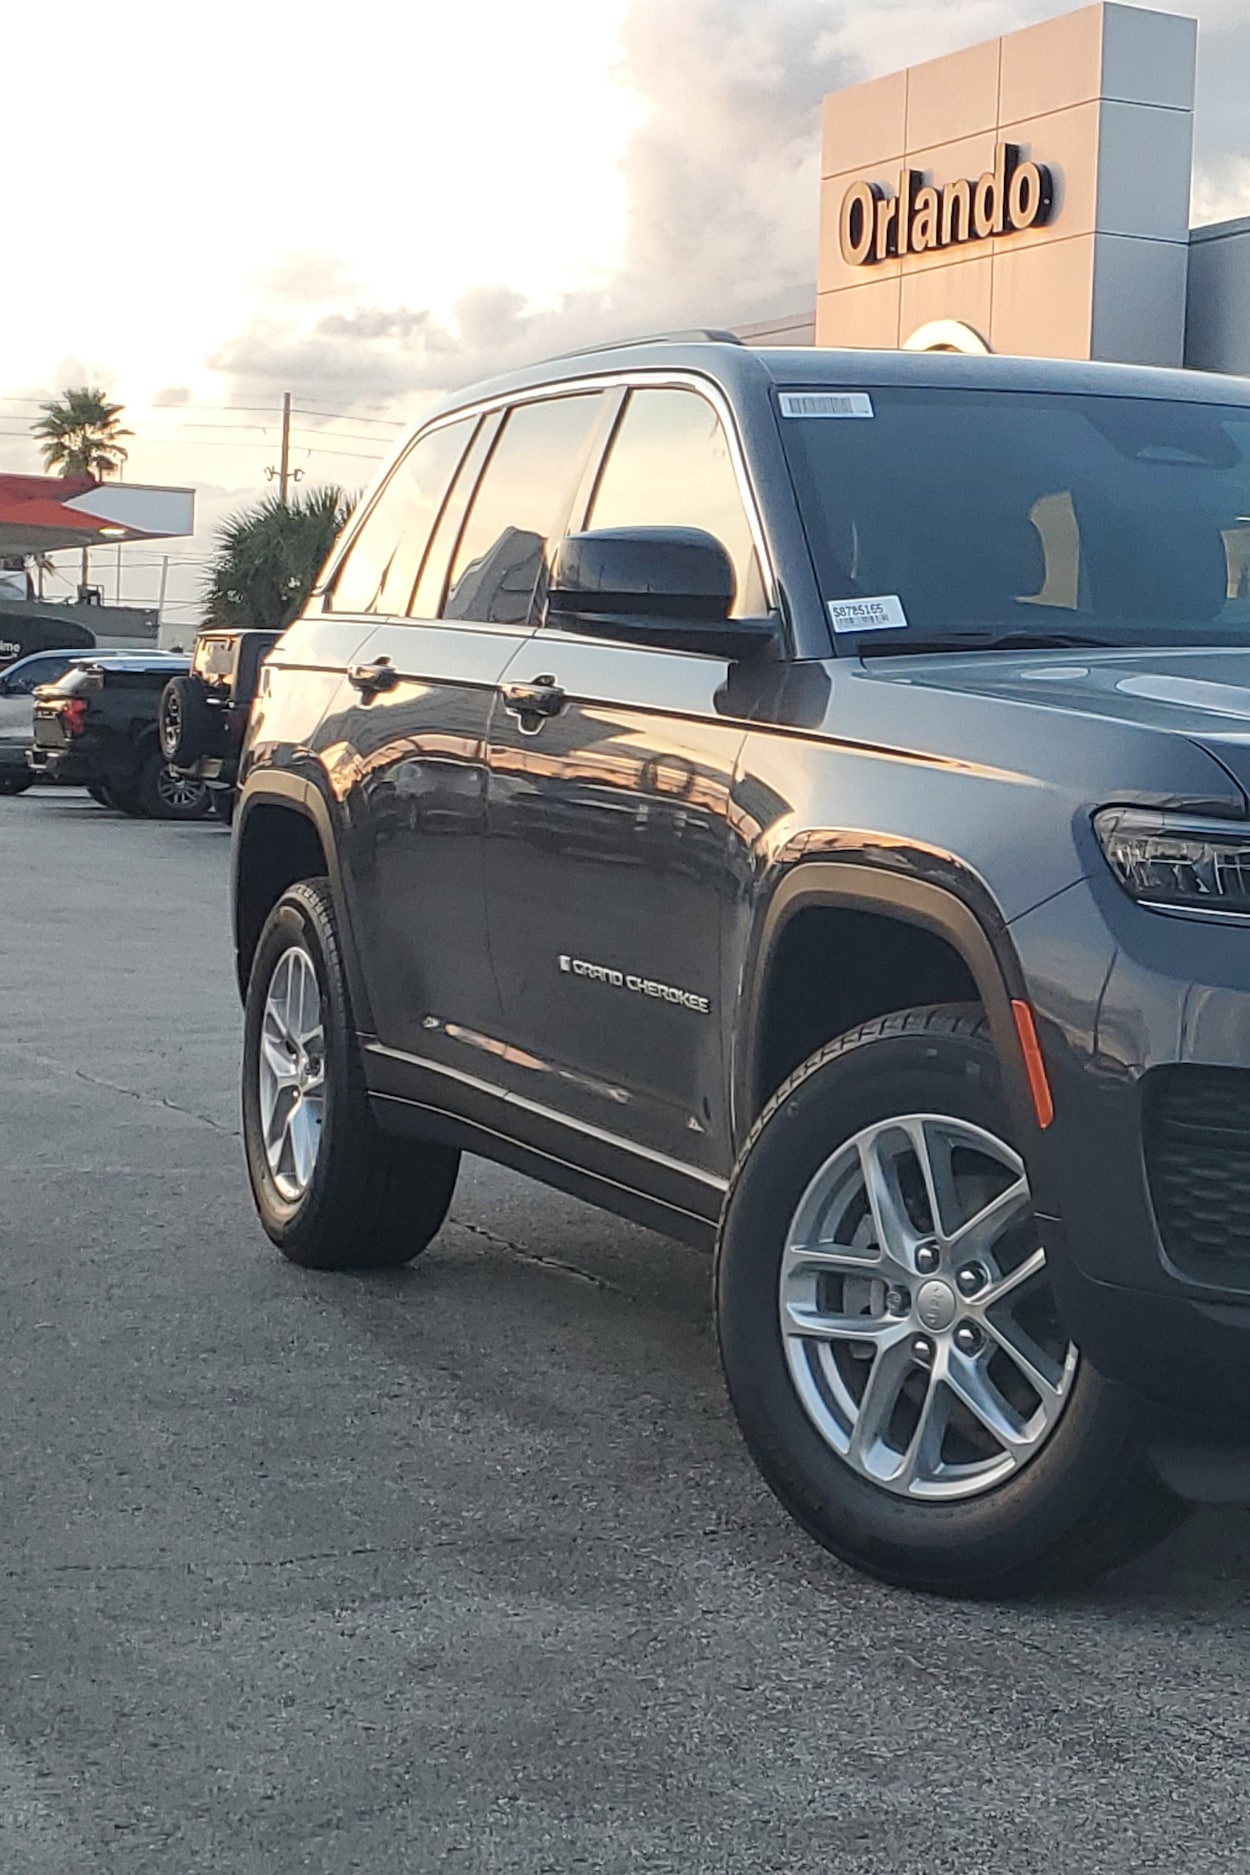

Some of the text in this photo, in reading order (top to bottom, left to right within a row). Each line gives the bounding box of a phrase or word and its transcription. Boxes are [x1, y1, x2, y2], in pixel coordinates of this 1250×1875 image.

[839, 143, 1053, 266] Orlando
[572, 959, 710, 1014] GRAND CHEROKEE
